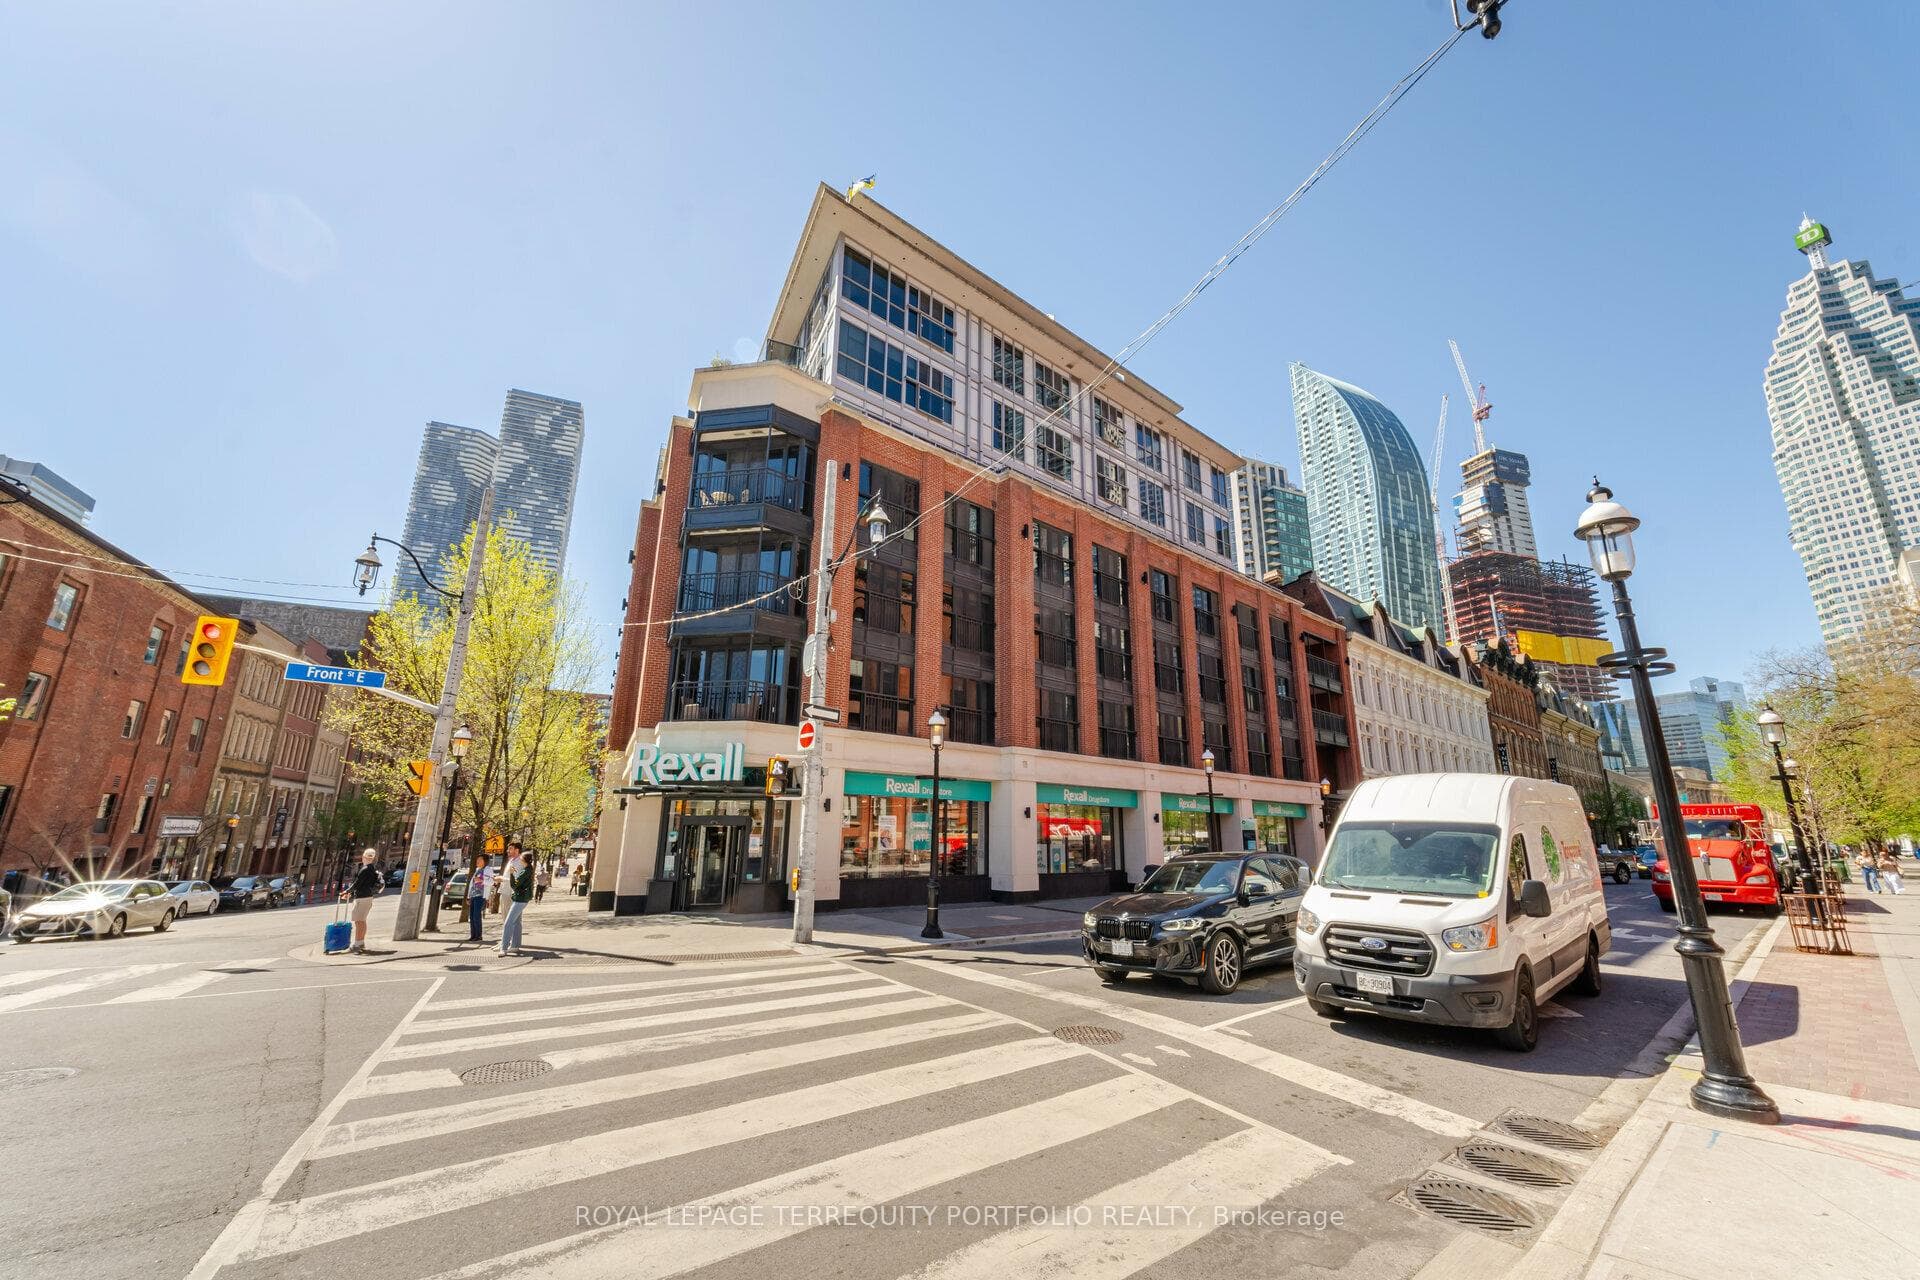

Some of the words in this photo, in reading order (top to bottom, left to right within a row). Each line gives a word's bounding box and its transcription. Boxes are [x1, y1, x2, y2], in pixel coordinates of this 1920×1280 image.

[1796, 228, 1820, 243] TD
[307, 666, 343, 681] Front
[356, 672, 366, 683] E
[631, 742, 744, 785] Rexall
[886, 778, 920, 794] Rexall
[922, 786, 953, 796] Drustore
[1063, 788, 1088, 803] Rexall
